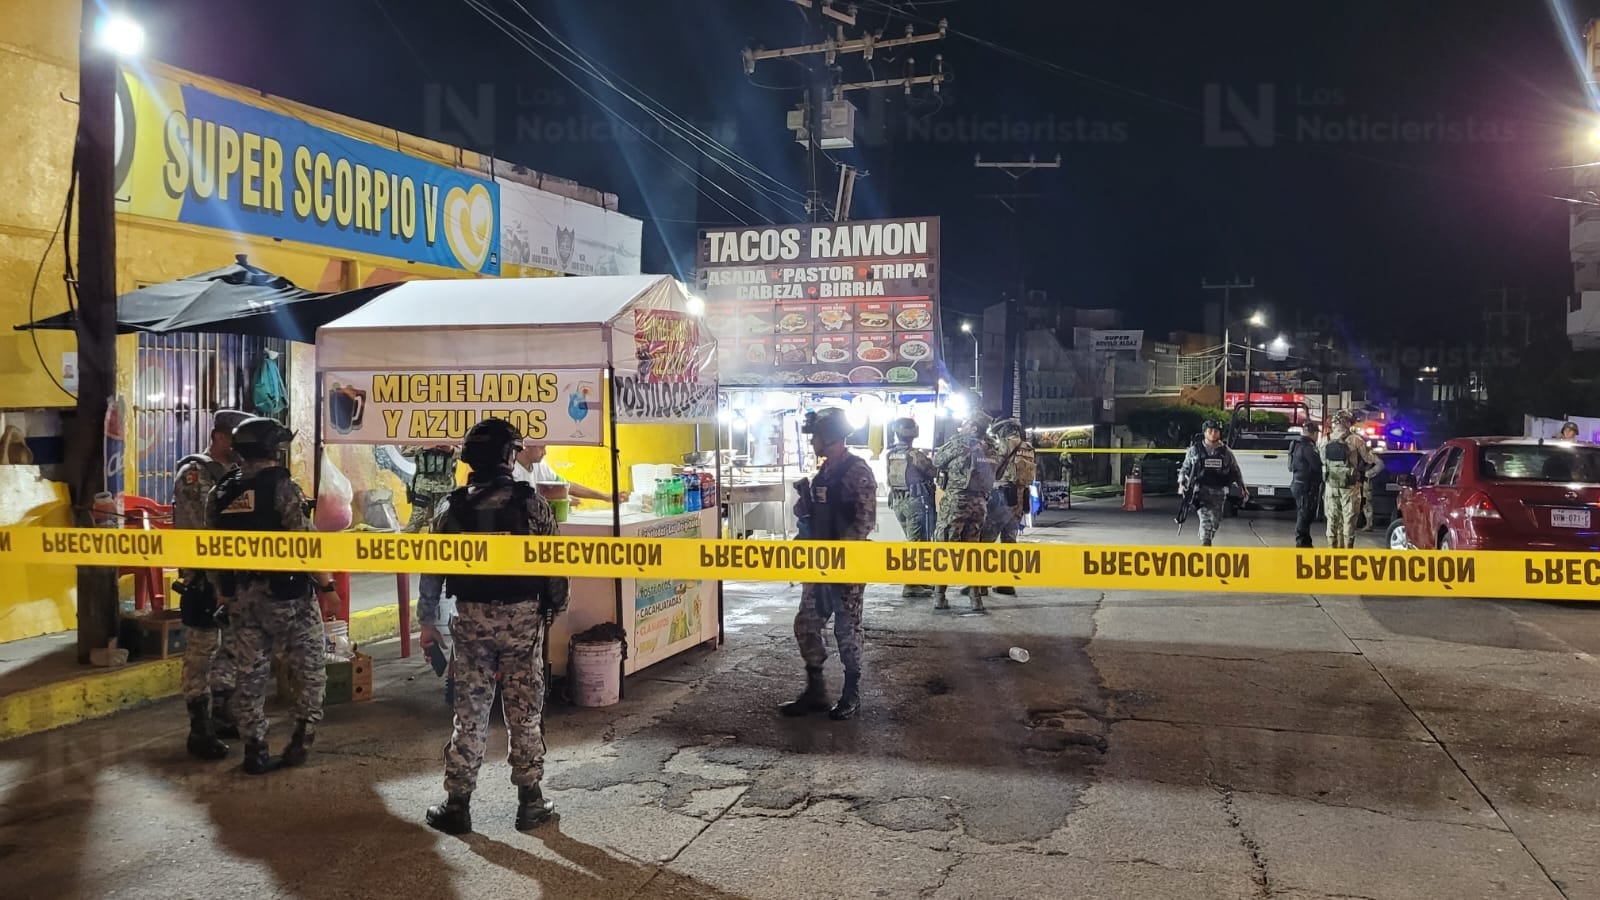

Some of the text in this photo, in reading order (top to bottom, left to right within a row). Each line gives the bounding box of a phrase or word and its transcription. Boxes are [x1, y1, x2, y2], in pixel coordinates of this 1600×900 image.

[164, 110, 440, 246] SUPER SCORPIO V
[706, 221, 927, 263] TACOS RAMON
[707, 263, 927, 287] ASADA PASTOR TRIPA
[737, 280, 885, 301] CABEZA BIRRIA
[373, 373, 557, 402] MICHELADAS
[383, 410, 402, 438] Y
[639, 594, 682, 618] CACAHUATADAS
